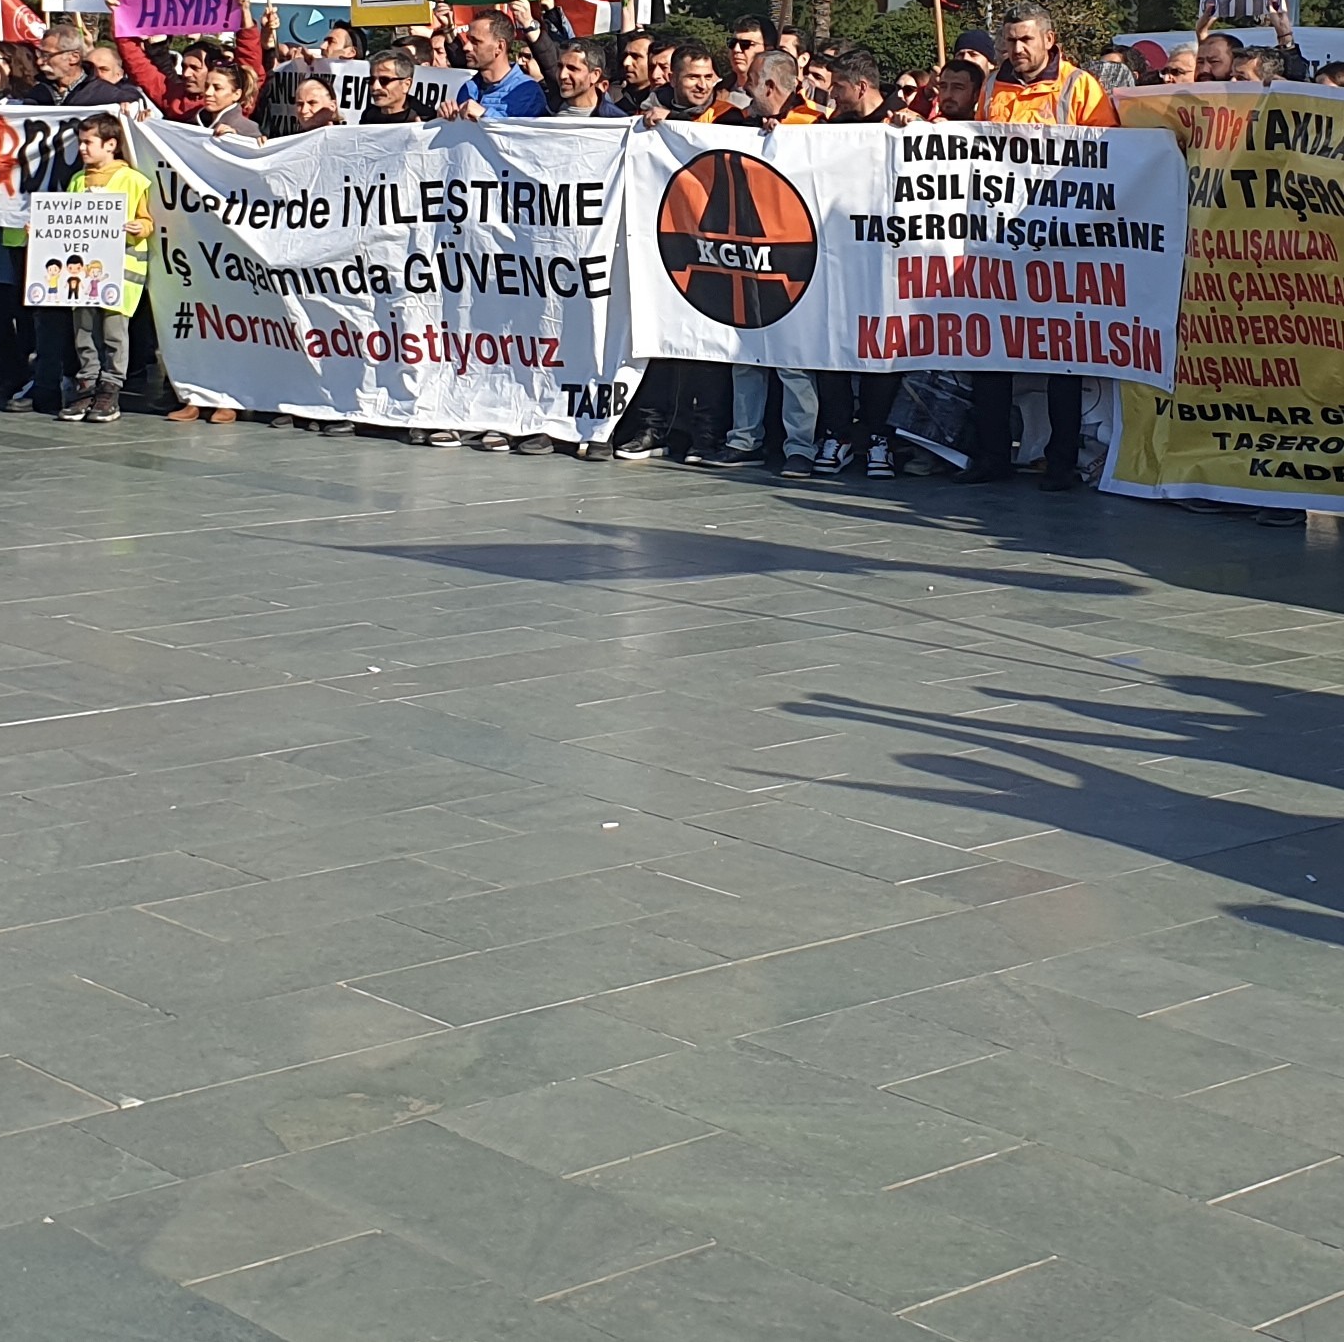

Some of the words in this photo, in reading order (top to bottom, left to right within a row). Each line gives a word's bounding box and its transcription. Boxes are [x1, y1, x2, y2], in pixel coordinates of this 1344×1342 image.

[902, 134, 1110, 171] KARAYOLLARI
[35, 198, 82, 210] TAYYİP
[87, 200, 123, 210] DEDE
[342, 169, 605, 236] İYİLEŞTİRME
[893, 174, 966, 203] ASIL
[971, 169, 1016, 210] İŞİ
[1024, 178, 1116, 212] YAPAN
[35, 228, 120, 239] KADROSUNU
[47, 215, 109, 225] BABAMIN
[849, 214, 989, 249] TAŞERON
[994, 214, 1167, 255] İŞÇİLERİNE
[63, 243, 90, 253] VER
[160, 226, 193, 288] İş
[197, 240, 393, 297] Yaşamında
[404, 242, 613, 299] GÜVENCE
[697, 240, 773, 273] KGM
[1202, 228, 1339, 268] ÇALIŞANLARI
[897, 255, 1018, 303] HAKKI
[1027, 260, 1128, 309] OLAN
[857, 312, 991, 361] KADRO
[999, 310, 1165, 375] VERİLSİN
[1177, 355, 1302, 393] ALIŞANLARI
[1178, 403, 1314, 427] BUNLAR
